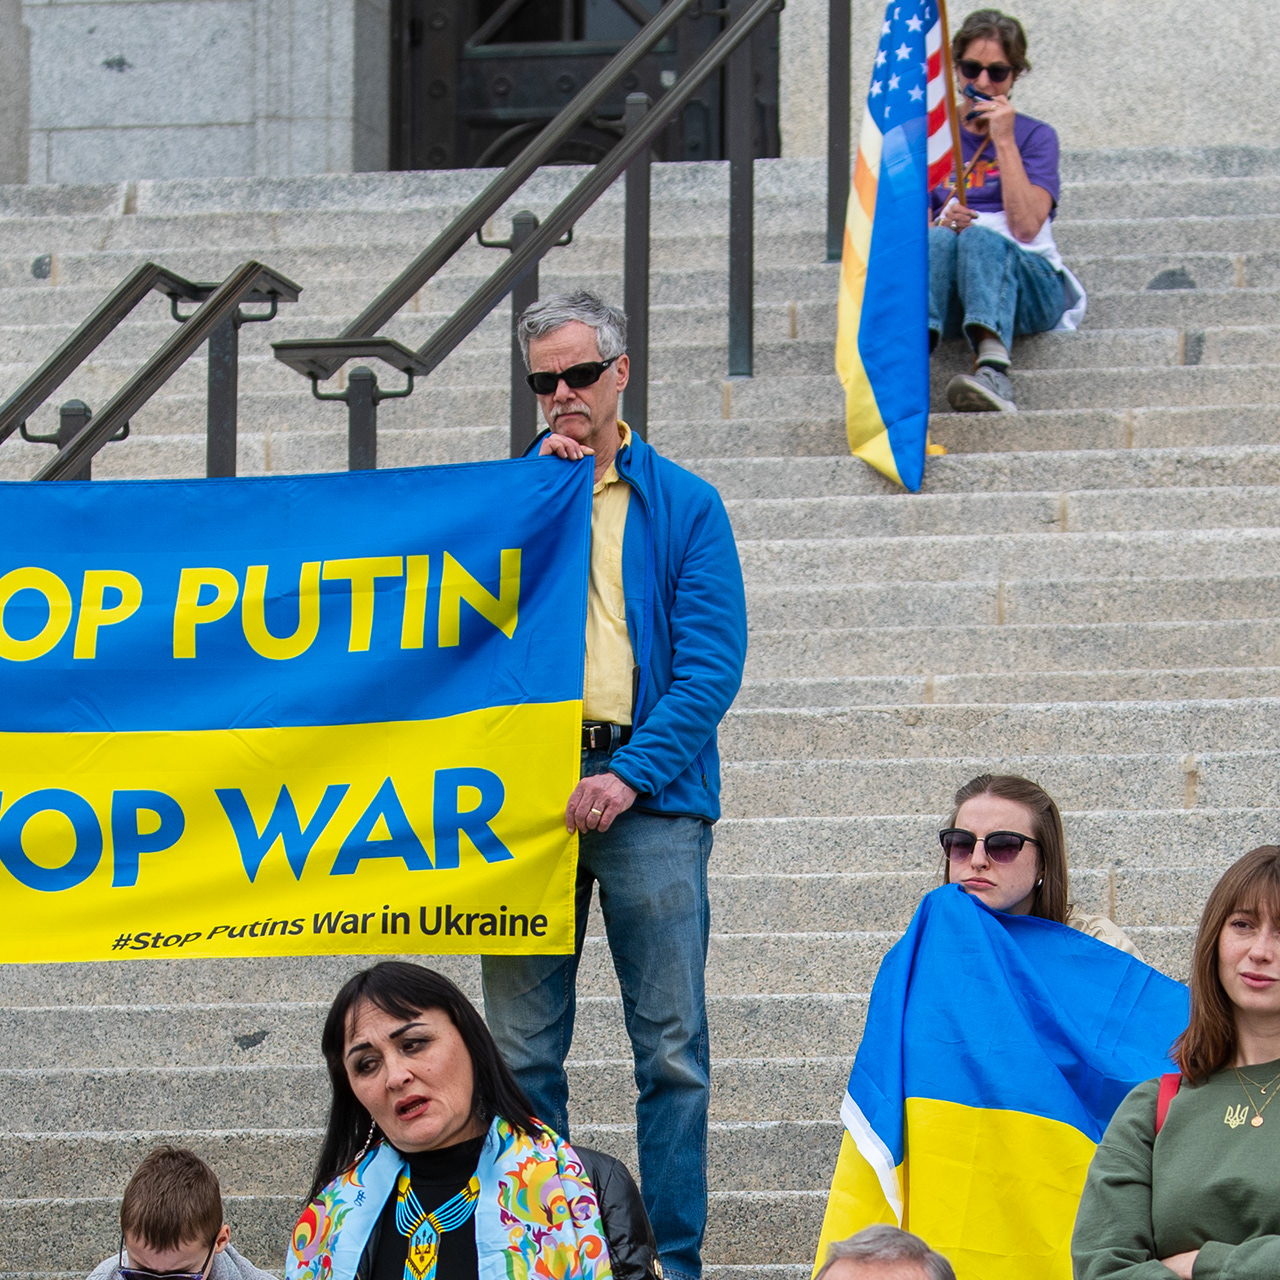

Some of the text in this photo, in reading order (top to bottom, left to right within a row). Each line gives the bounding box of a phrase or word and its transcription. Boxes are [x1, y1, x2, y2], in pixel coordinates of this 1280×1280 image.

[173, 547, 523, 661] PUTIN
[214, 767, 515, 884] WAR
[110, 904, 549, 952] #Stop Putins War in Ukraine
